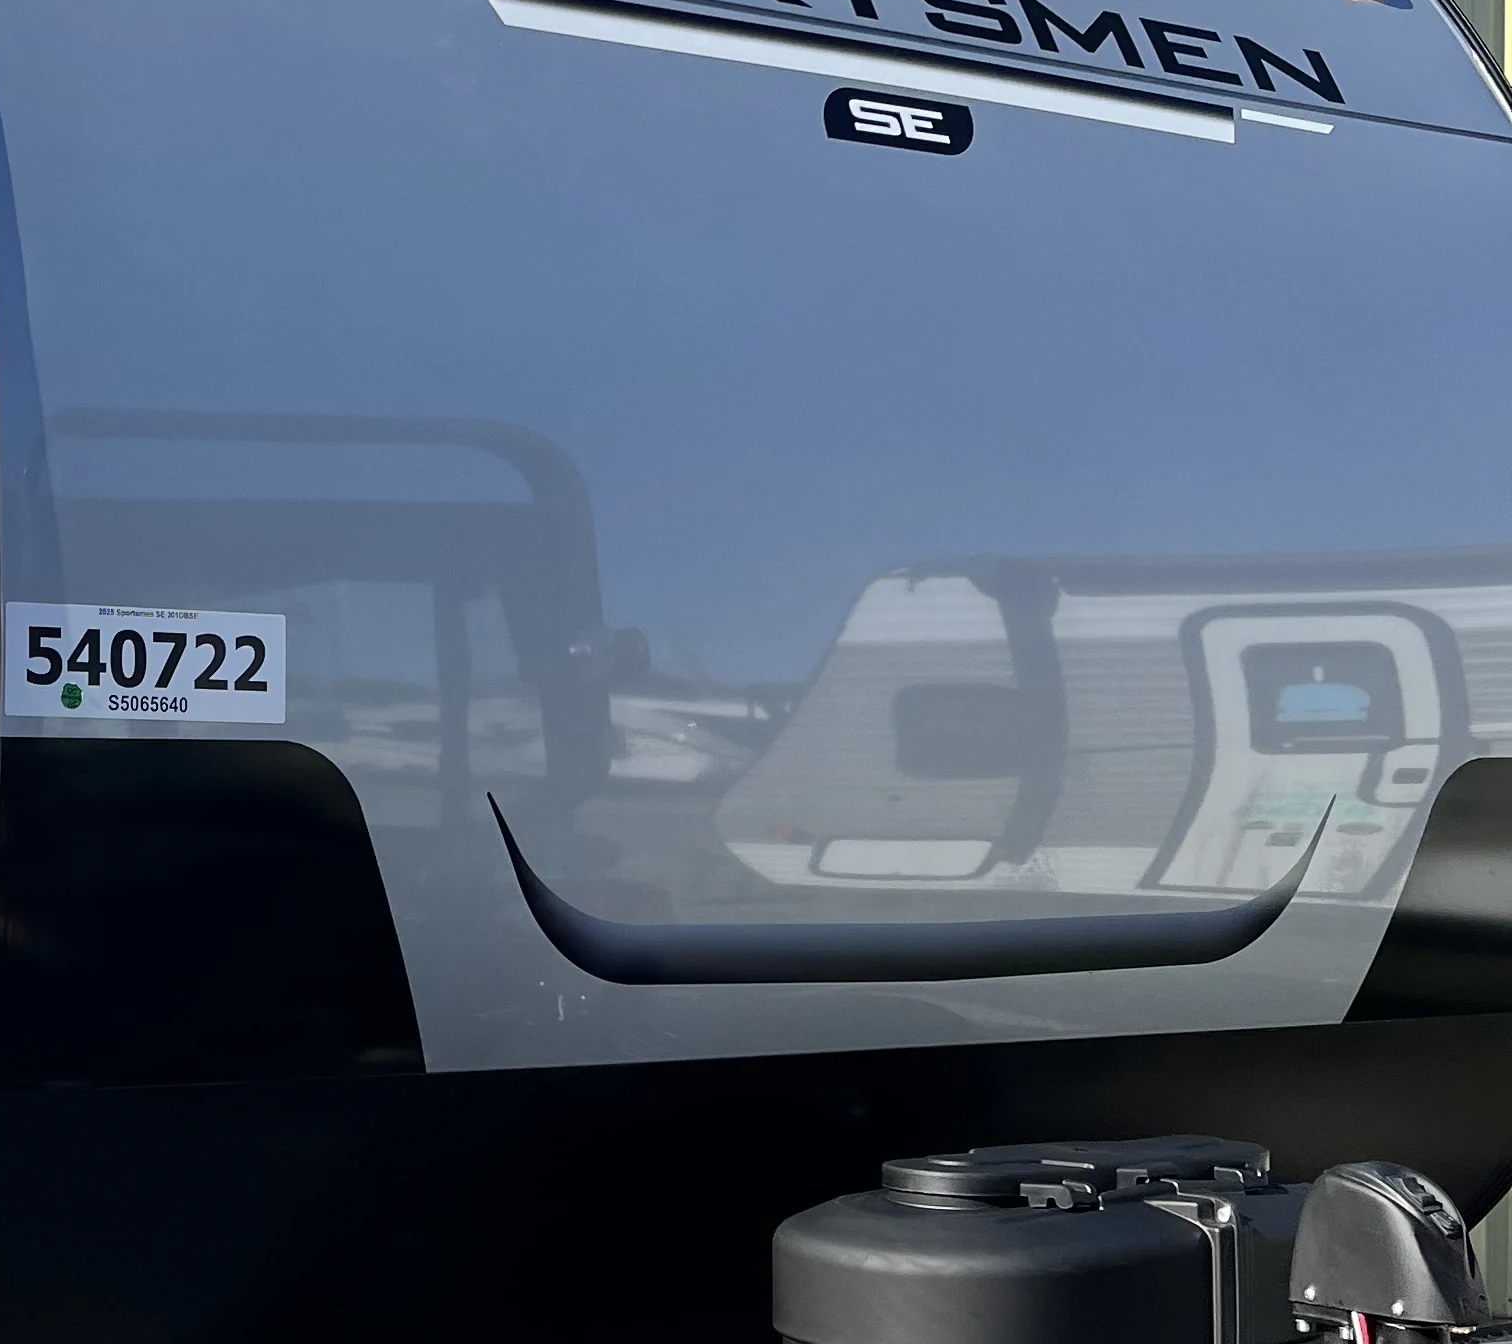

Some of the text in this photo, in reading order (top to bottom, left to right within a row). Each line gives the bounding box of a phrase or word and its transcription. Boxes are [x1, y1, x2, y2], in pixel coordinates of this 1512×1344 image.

[848, 98, 951, 145] SE
[26, 625, 268, 692] 540722
[108, 694, 189, 713] S5065640
